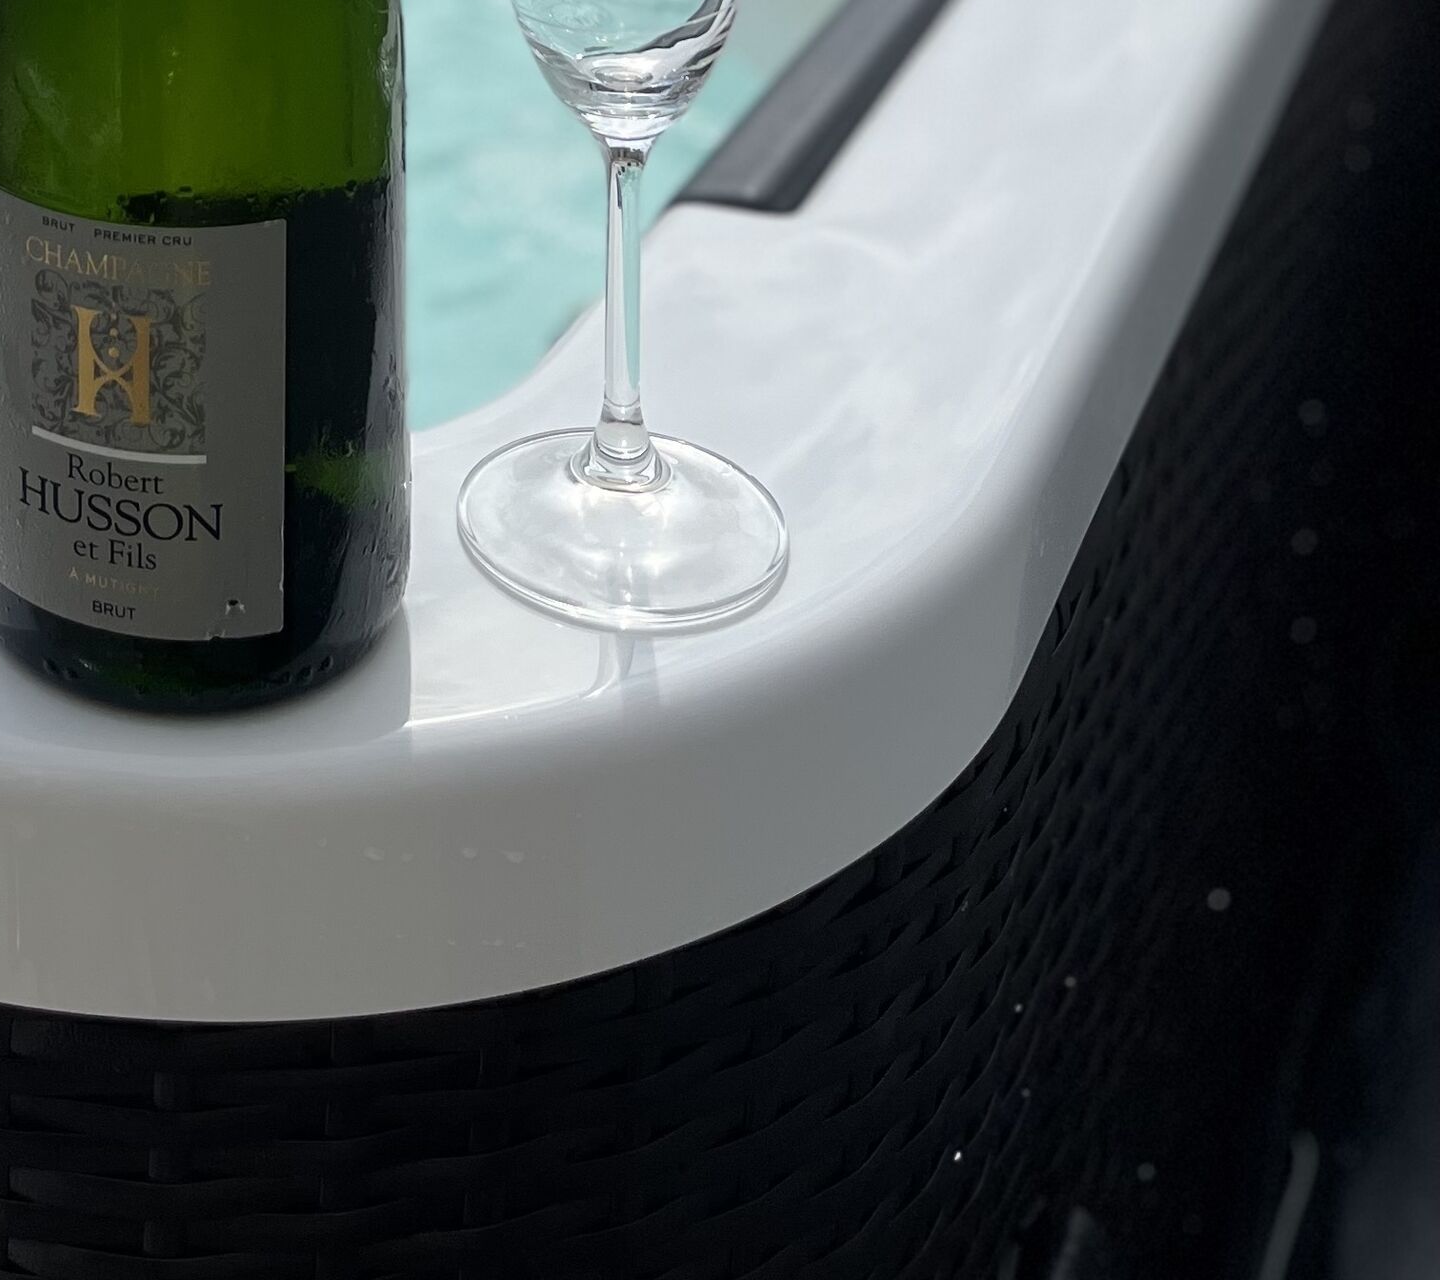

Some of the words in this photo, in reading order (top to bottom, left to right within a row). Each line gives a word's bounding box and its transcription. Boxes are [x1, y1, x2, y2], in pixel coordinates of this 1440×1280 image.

[42, 216, 75, 233] BRUT
[94, 228, 156, 245] PREMIER
[162, 235, 192, 246] CRU
[67, 452, 164, 494] Robert
[19, 466, 223, 541] HUSSON
[73, 539, 99, 560] et
[109, 539, 157, 570] Fils
[92, 600, 136, 620] BRUT
